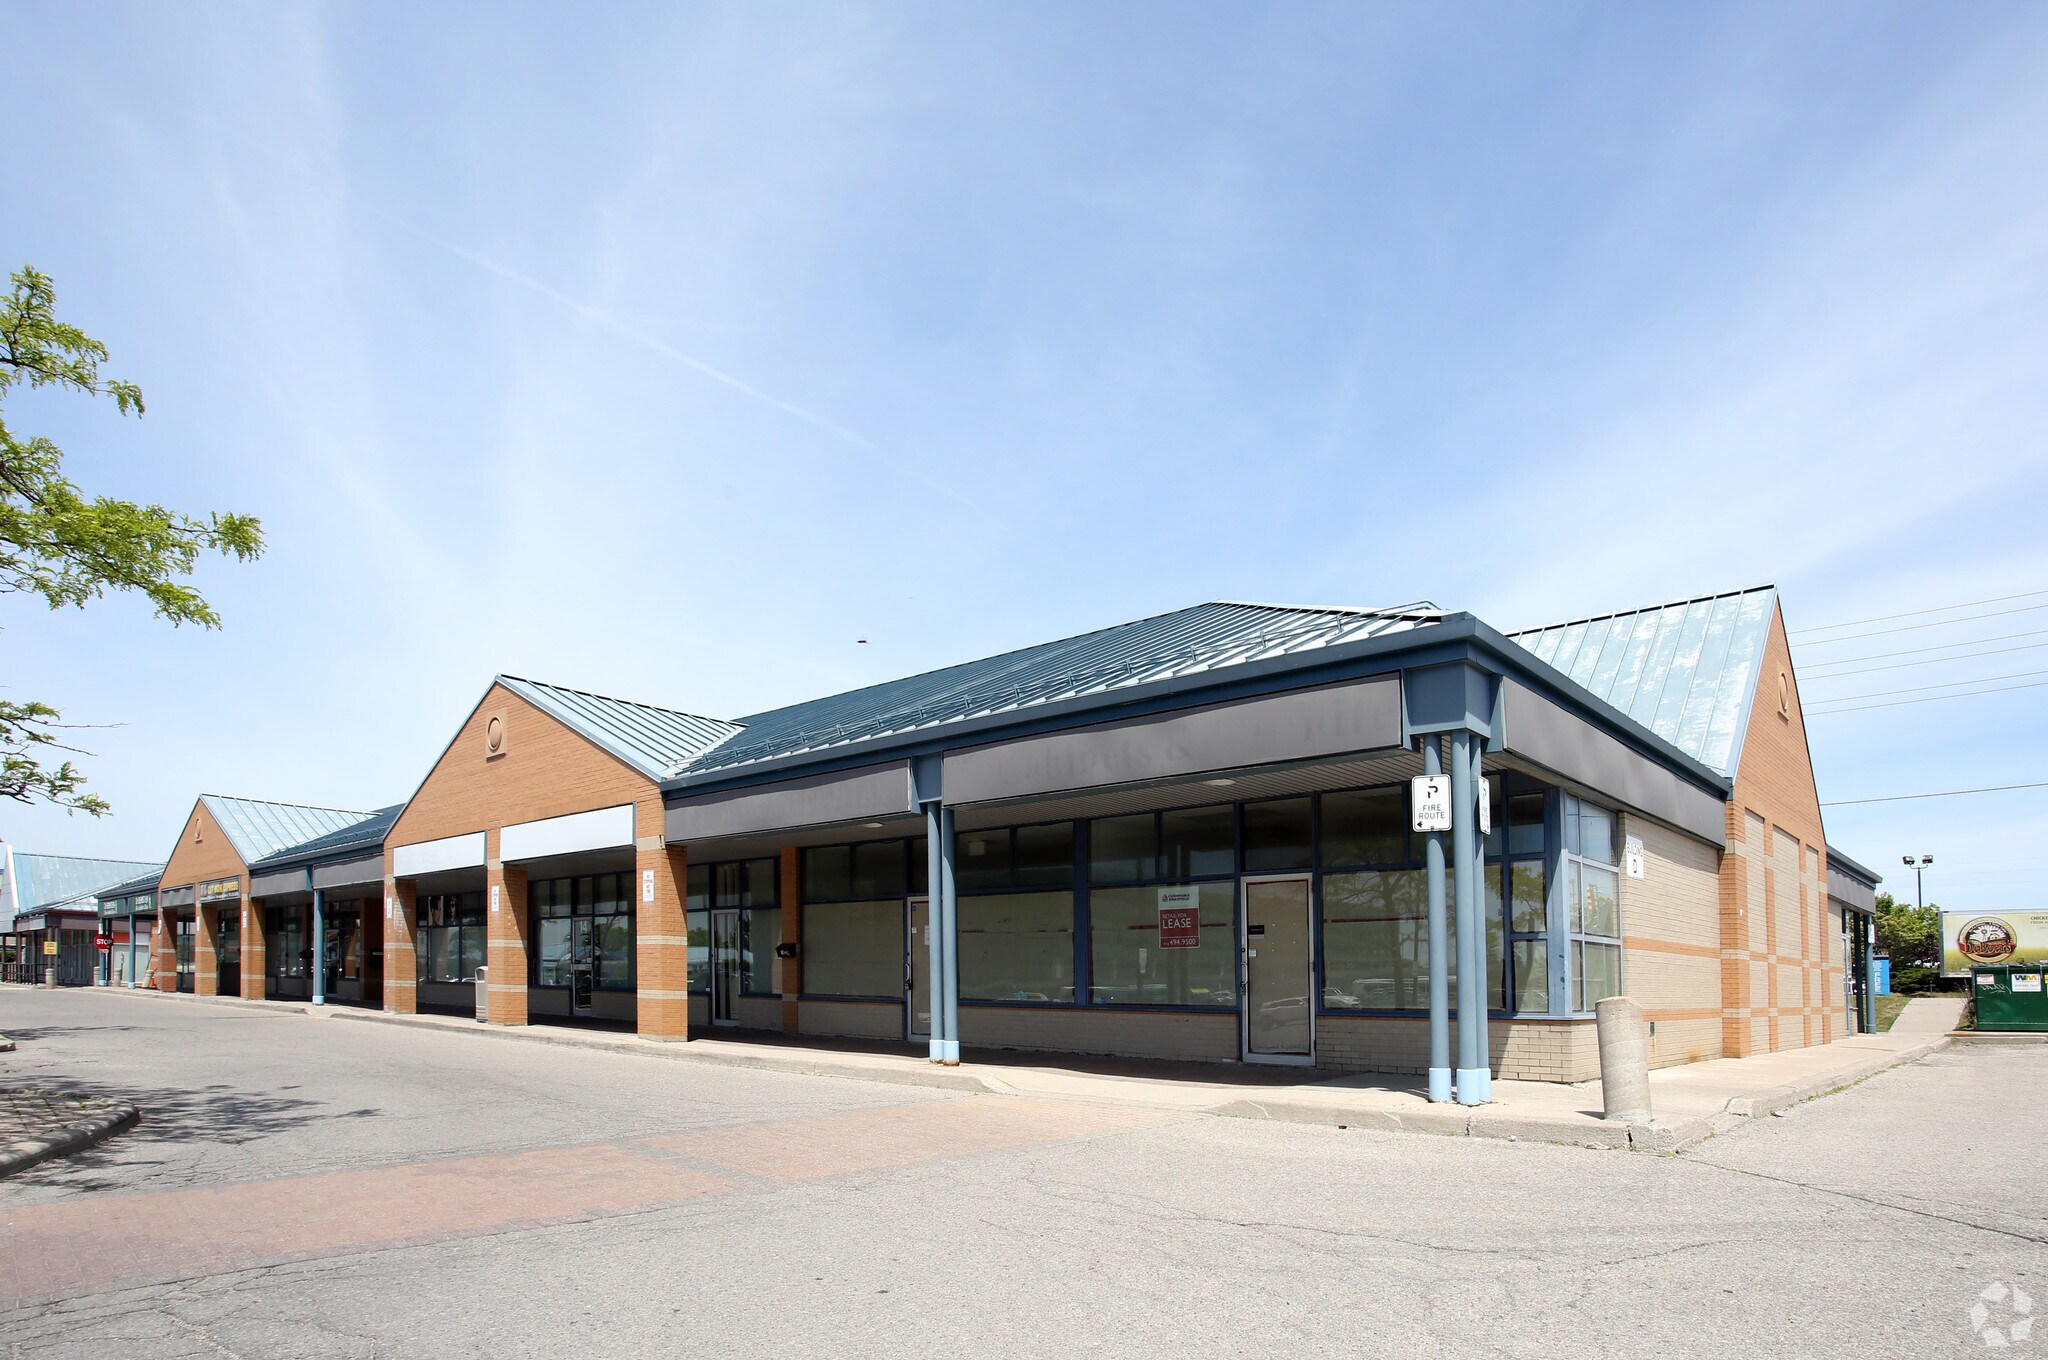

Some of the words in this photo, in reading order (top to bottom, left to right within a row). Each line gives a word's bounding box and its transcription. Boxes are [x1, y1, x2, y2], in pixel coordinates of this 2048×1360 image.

[1422, 804, 1442, 812] FIRE
[1418, 811, 1445, 820] ROUTE
[1633, 859, 1637, 873] D
[1162, 918, 1191, 929] LEASE
